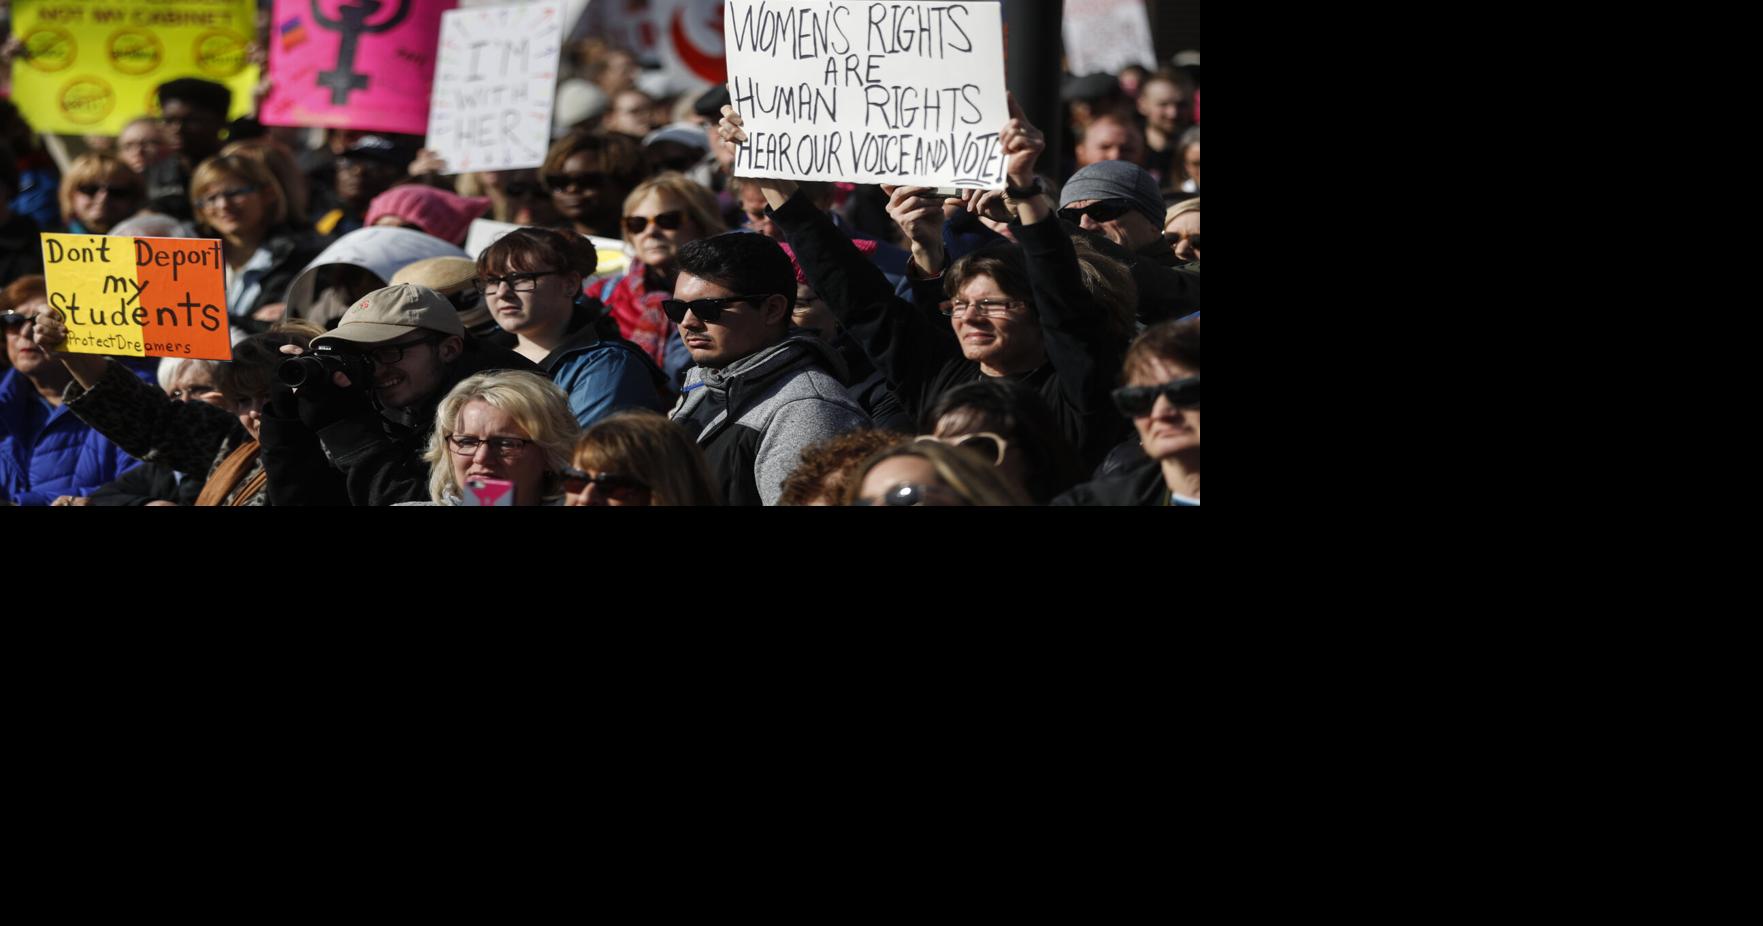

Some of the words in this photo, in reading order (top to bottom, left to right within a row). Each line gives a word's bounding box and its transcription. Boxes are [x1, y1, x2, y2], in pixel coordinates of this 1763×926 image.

[730, 1, 850, 59] WOMEN'S
[867, 2, 972, 59] RIGHTS
[824, 54, 885, 87] ARE
[454, 83, 529, 110] WITH
[735, 76, 837, 124] HUMAN
[865, 83, 982, 132] RIGHTS
[454, 107, 523, 148] HER
[737, 132, 796, 175] HEAR
[796, 131, 844, 176] OUR
[850, 131, 913, 175] VOICE
[913, 134, 949, 176] AND
[46, 237, 111, 264] Don't
[134, 239, 221, 281] Deport
[103, 275, 149, 306] my
[50, 291, 220, 332] Students
